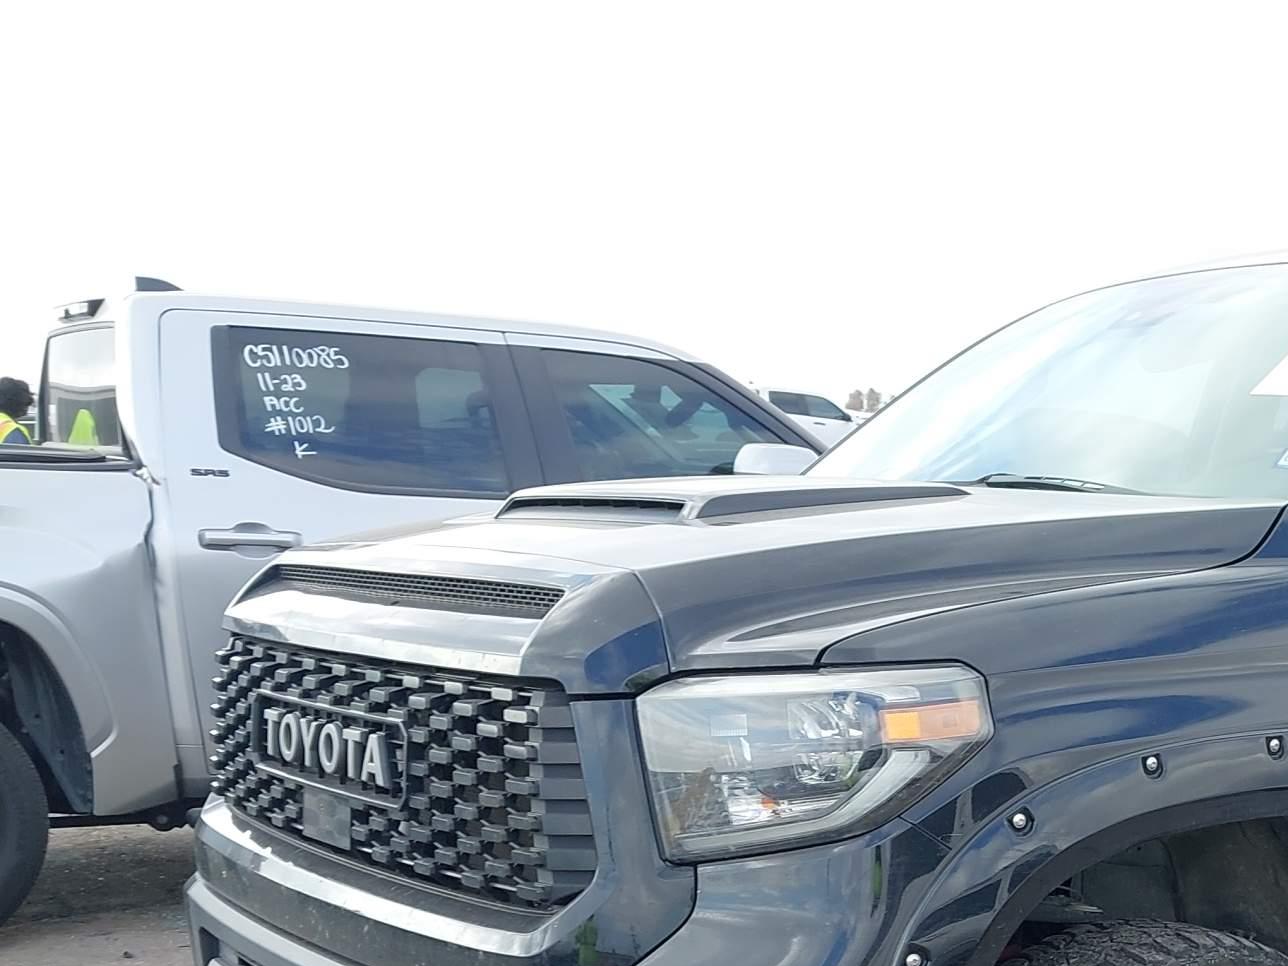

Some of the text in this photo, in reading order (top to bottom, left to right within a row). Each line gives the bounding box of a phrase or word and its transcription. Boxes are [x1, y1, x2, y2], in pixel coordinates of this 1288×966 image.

[243, 344, 349, 369] C5110085
[257, 373, 307, 391] 11-23
[263, 396, 304, 413] ACC
[264, 415, 336, 436] #1012
[264, 707, 392, 789] TOYOTA
